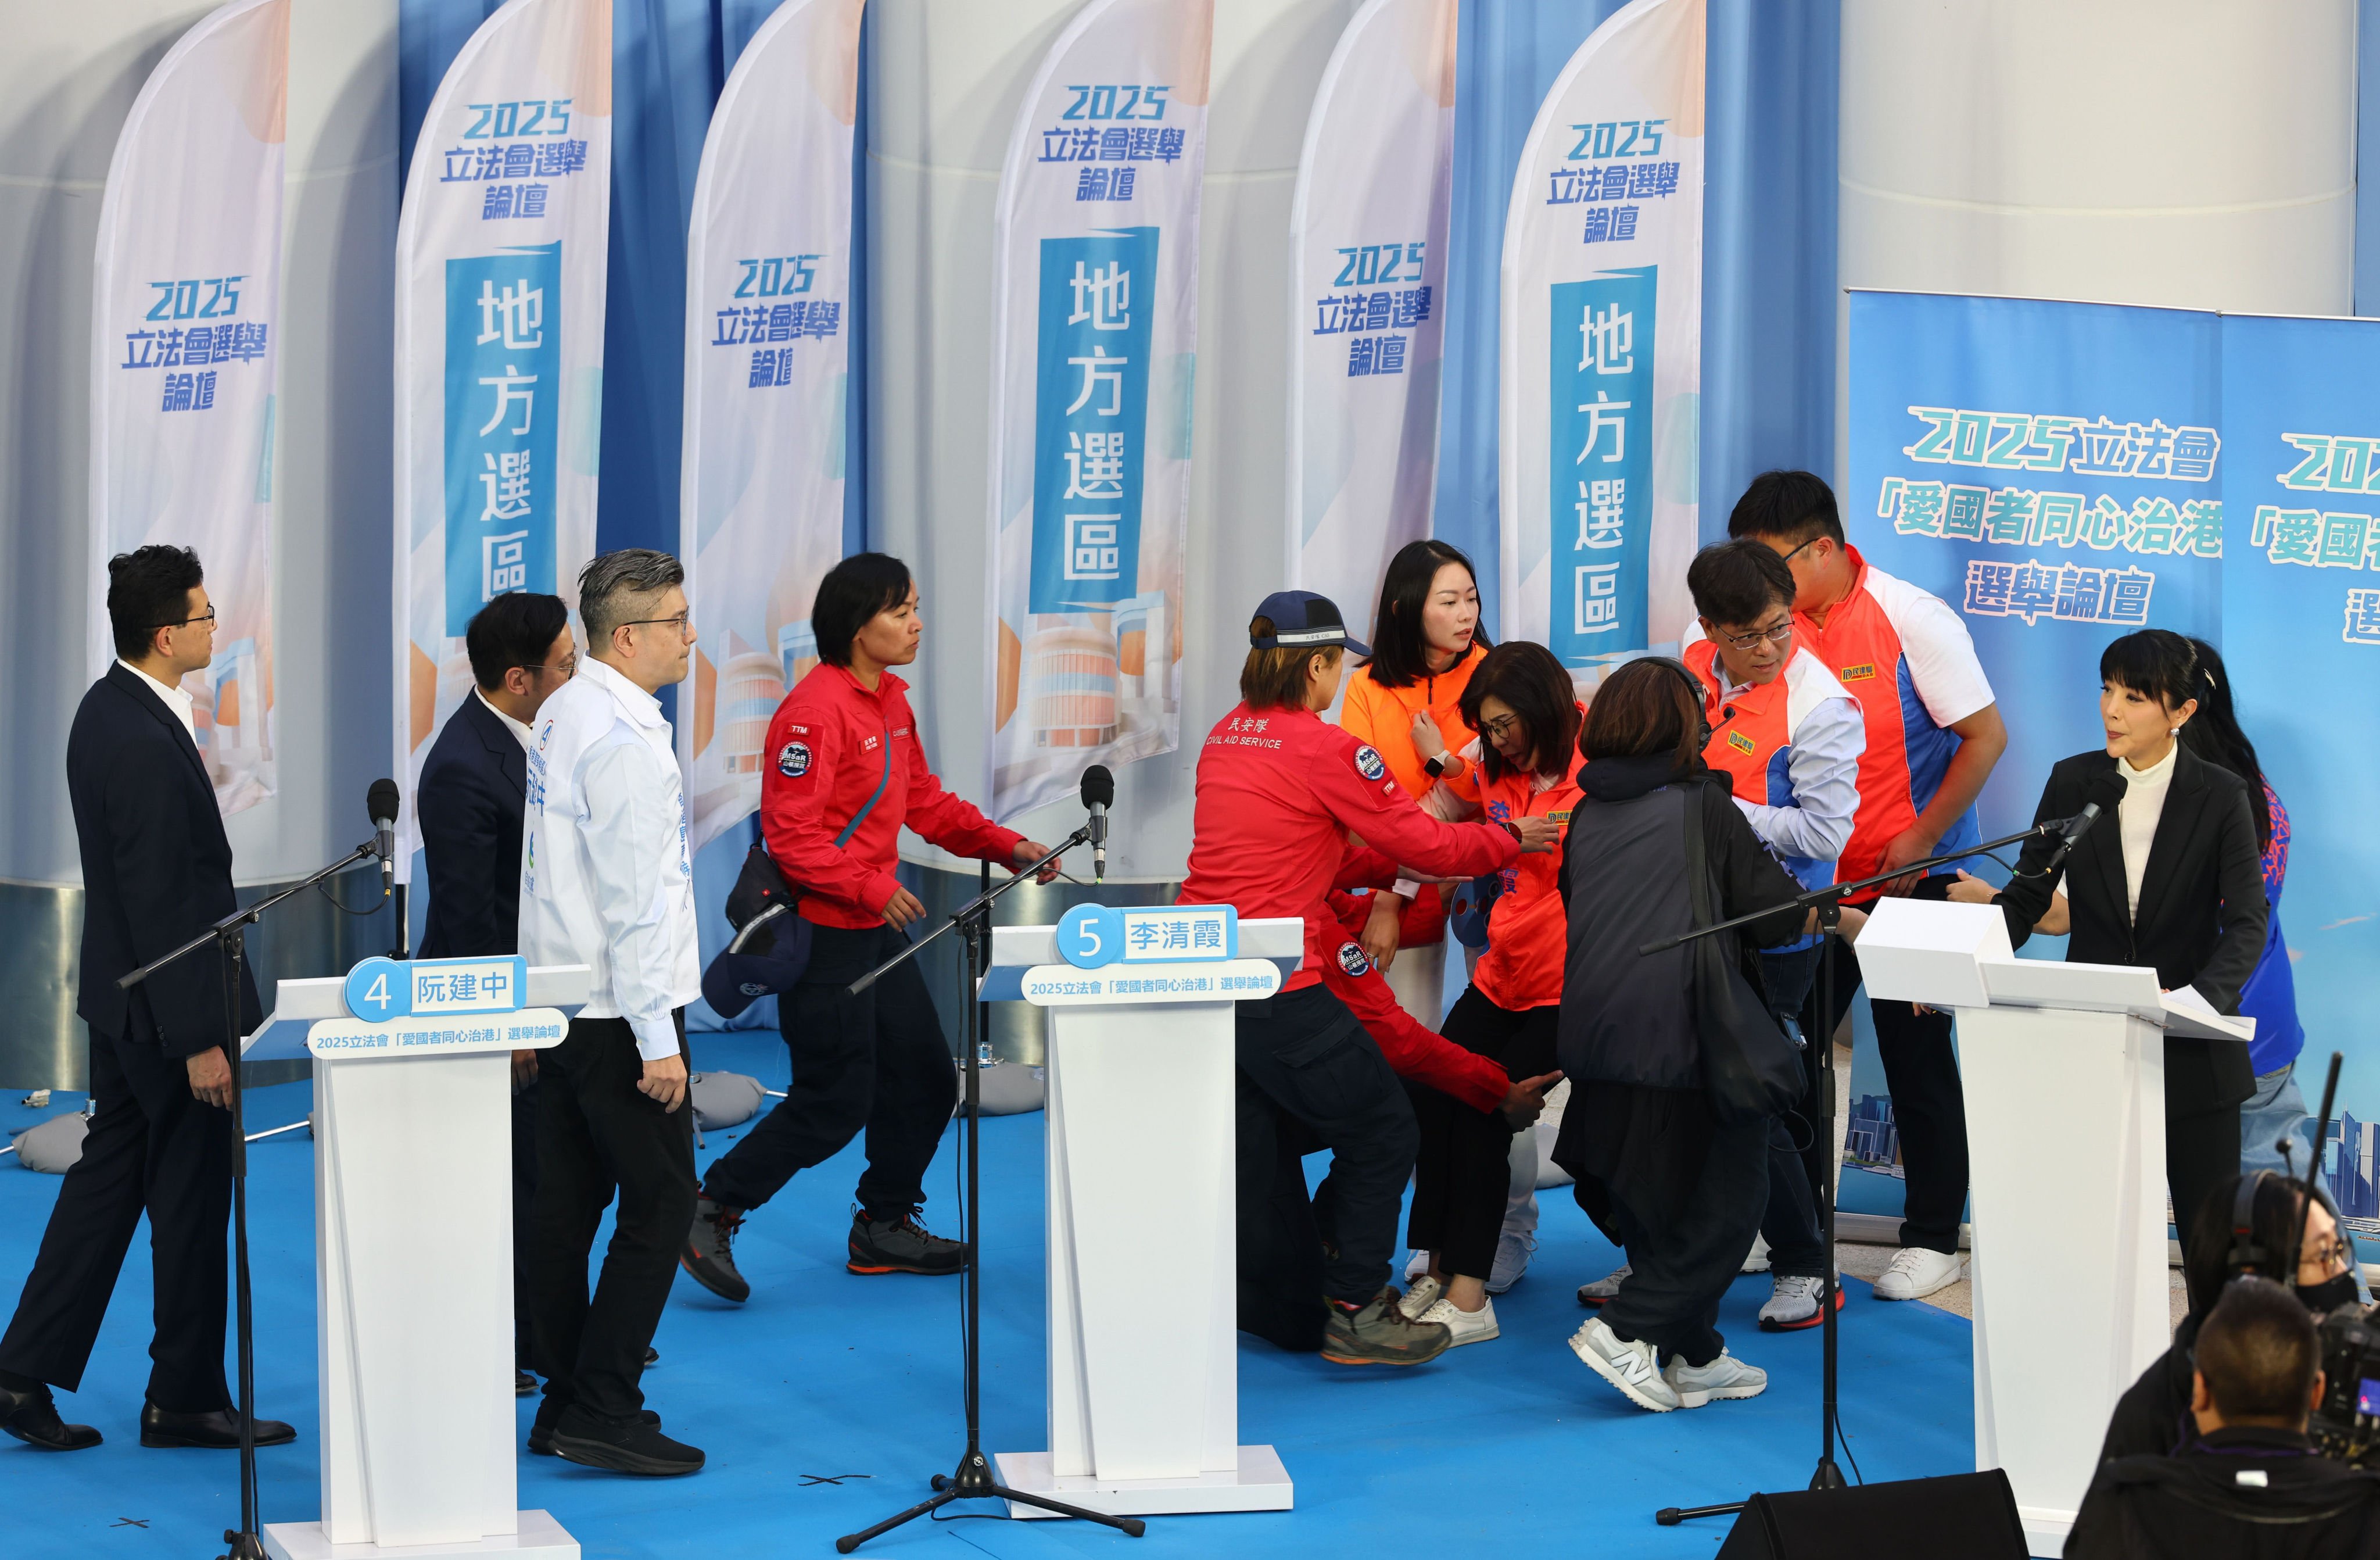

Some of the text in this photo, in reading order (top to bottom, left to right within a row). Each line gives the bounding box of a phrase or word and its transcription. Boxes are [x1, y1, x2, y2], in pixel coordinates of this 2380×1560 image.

[463, 98, 576, 140] 2025
[1060, 85, 1177, 120] 2025
[439, 139, 587, 183] 立法會選舉
[1037, 126, 1185, 166] 立法會選舉
[1563, 119, 1671, 161] 2025
[482, 183, 549, 221] 論壇
[1076, 166, 1136, 202] 論壇
[1546, 161, 1680, 205] 立法會選舉
[1583, 204, 1639, 244] 論壇
[731, 255, 829, 299] 2025
[1330, 242, 1425, 287] 2025
[142, 276, 250, 321] 2025
[1313, 286, 1432, 335] 立法會選舉
[712, 300, 841, 346] 立法會選舉
[122, 320, 268, 369] 立法會選舉
[1347, 335, 1407, 377] 論壇
[748, 348, 794, 388] 論壇
[162, 370, 217, 412] 論壇
[476, 280, 543, 602] 地方選區
[1063, 262, 1130, 580] 地方選區
[1903, 406, 2221, 482] 2025立法會
[2277, 432, 2380, 494] 20
[1573, 303, 1633, 634] 地方選區
[1964, 559, 2155, 626] 選舉論壇
[791, 725, 808, 734] TTM
[1206, 735, 1282, 749] CIVIL AID SERVICE
[1228, 717, 1269, 733] 民安隊
[784, 752, 806, 761] MSaR
[1362, 753, 1377, 768] MSaR
[1384, 781, 1395, 793] TTM
[1078, 918, 1221, 957] 5 李清霞
[1343, 951, 1361, 963] MSaR
[364, 971, 507, 1010] 4 阮建中
[1031, 975, 1273, 996] 2025立法會「愛國者同心治港」選舉論壇
[317, 1024, 561, 1049] 2025立法會「愛國者同心治港」選舉論壇
